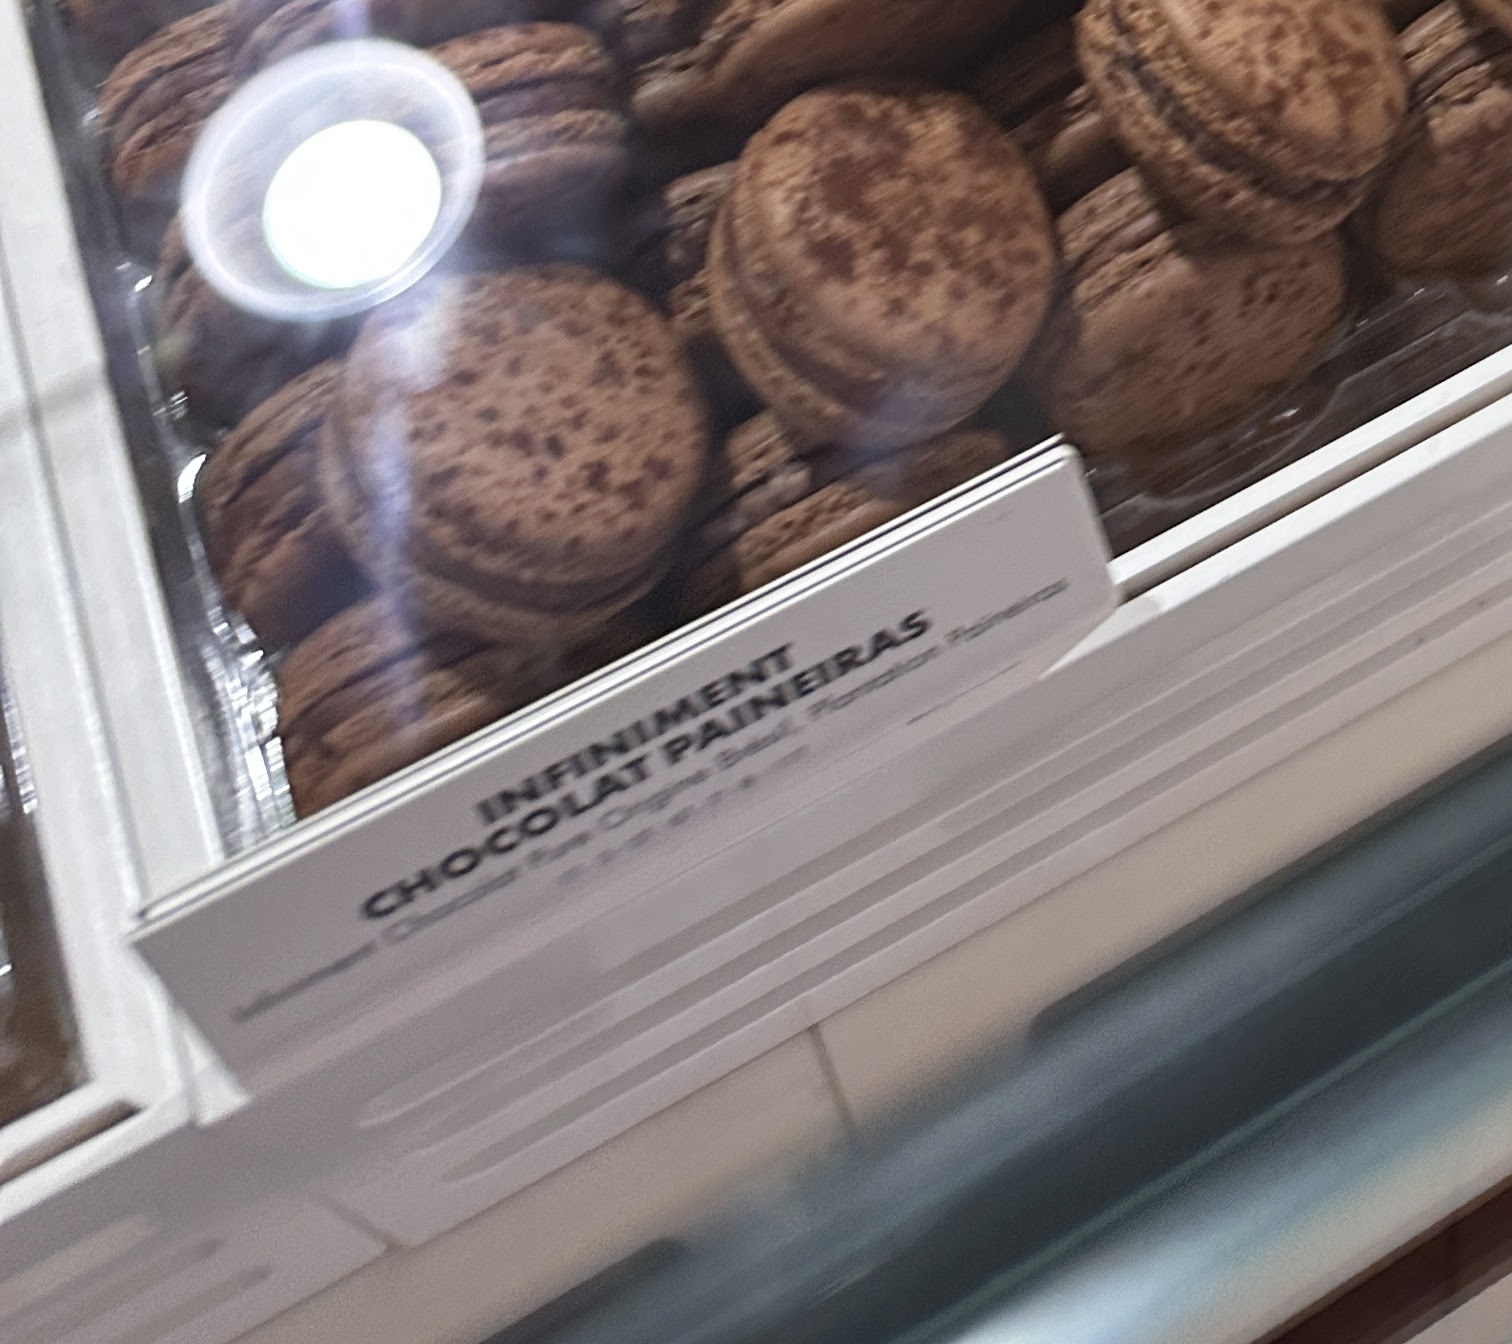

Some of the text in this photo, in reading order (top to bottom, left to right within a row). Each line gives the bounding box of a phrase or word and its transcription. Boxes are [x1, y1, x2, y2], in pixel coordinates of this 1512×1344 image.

[359, 753, 660, 922] CHOCOLAT
[666, 607, 932, 766] PAINEIRAS
[476, 640, 795, 825] INFINIMENT
